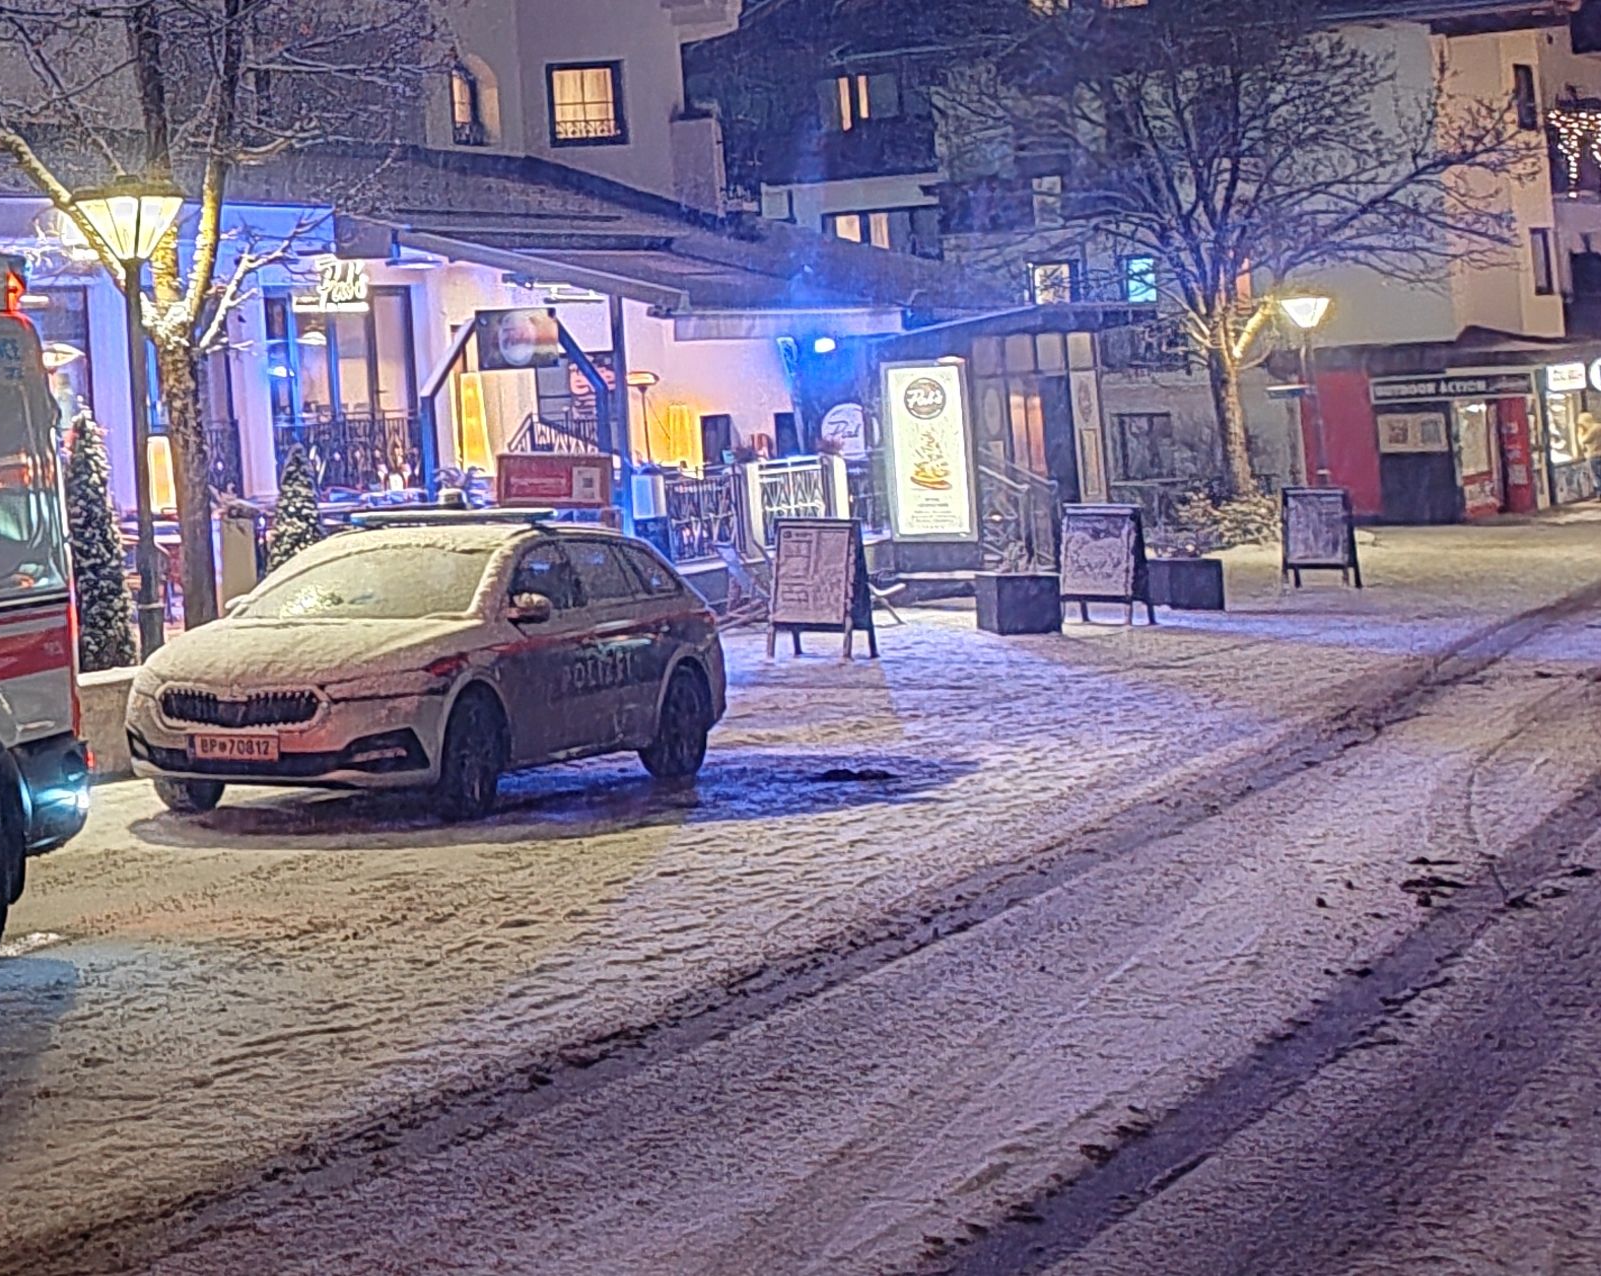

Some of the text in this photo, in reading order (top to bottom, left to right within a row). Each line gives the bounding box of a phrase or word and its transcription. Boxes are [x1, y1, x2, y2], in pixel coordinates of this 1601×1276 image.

[1439, 379, 1487, 395] ACTION
[200, 738, 271, 756] BP 70812
